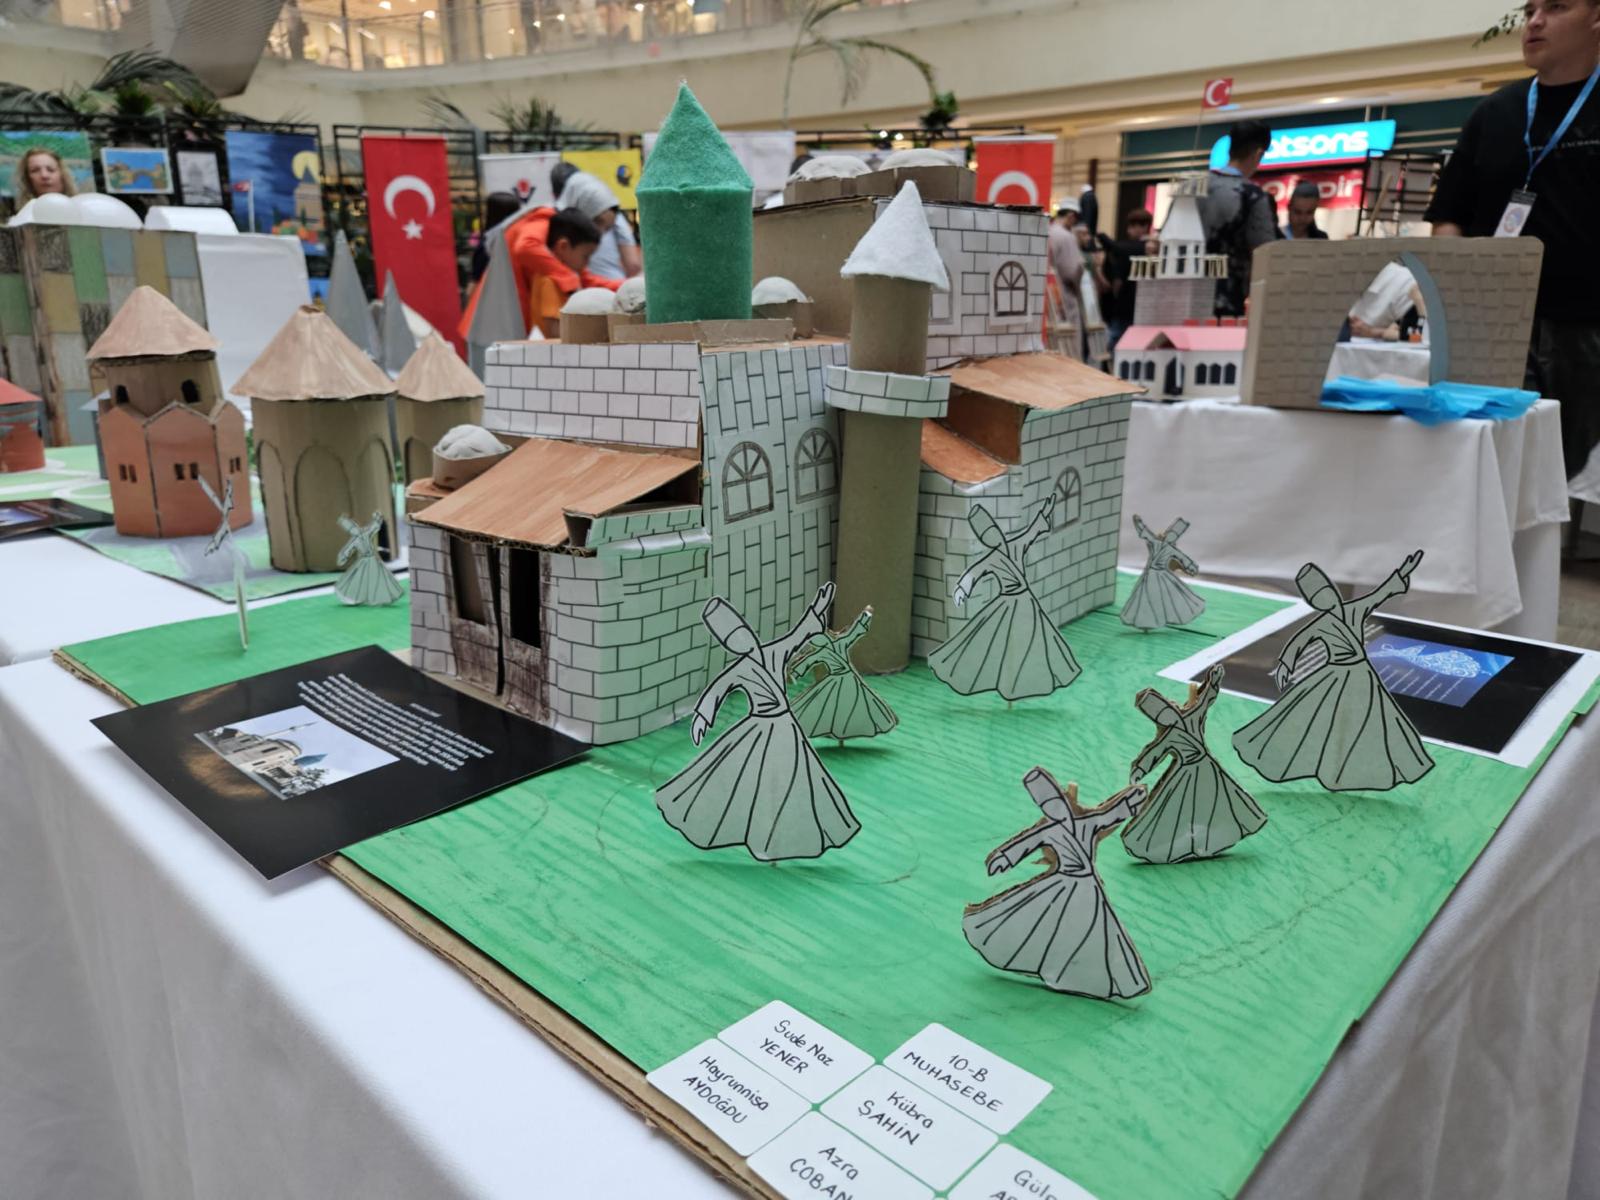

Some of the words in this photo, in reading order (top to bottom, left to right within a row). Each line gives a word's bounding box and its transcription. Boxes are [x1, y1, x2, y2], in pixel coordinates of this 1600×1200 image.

[1264, 131, 1369, 159] atsons
[759, 1038, 809, 1074] YENER
[774, 1019, 807, 1049] Sude
[806, 1043, 835, 1067] Naz
[699, 1055, 770, 1112] Hayrunnisa
[903, 1051, 1003, 1113] MUHASEBE
[948, 1054, 989, 1083] 10-B
[683, 1075, 748, 1124] AYDOĞDU
[886, 1091, 934, 1129] Kübra
[857, 1099, 921, 1146] ŞAHİN
[818, 1147, 859, 1181] Azra
